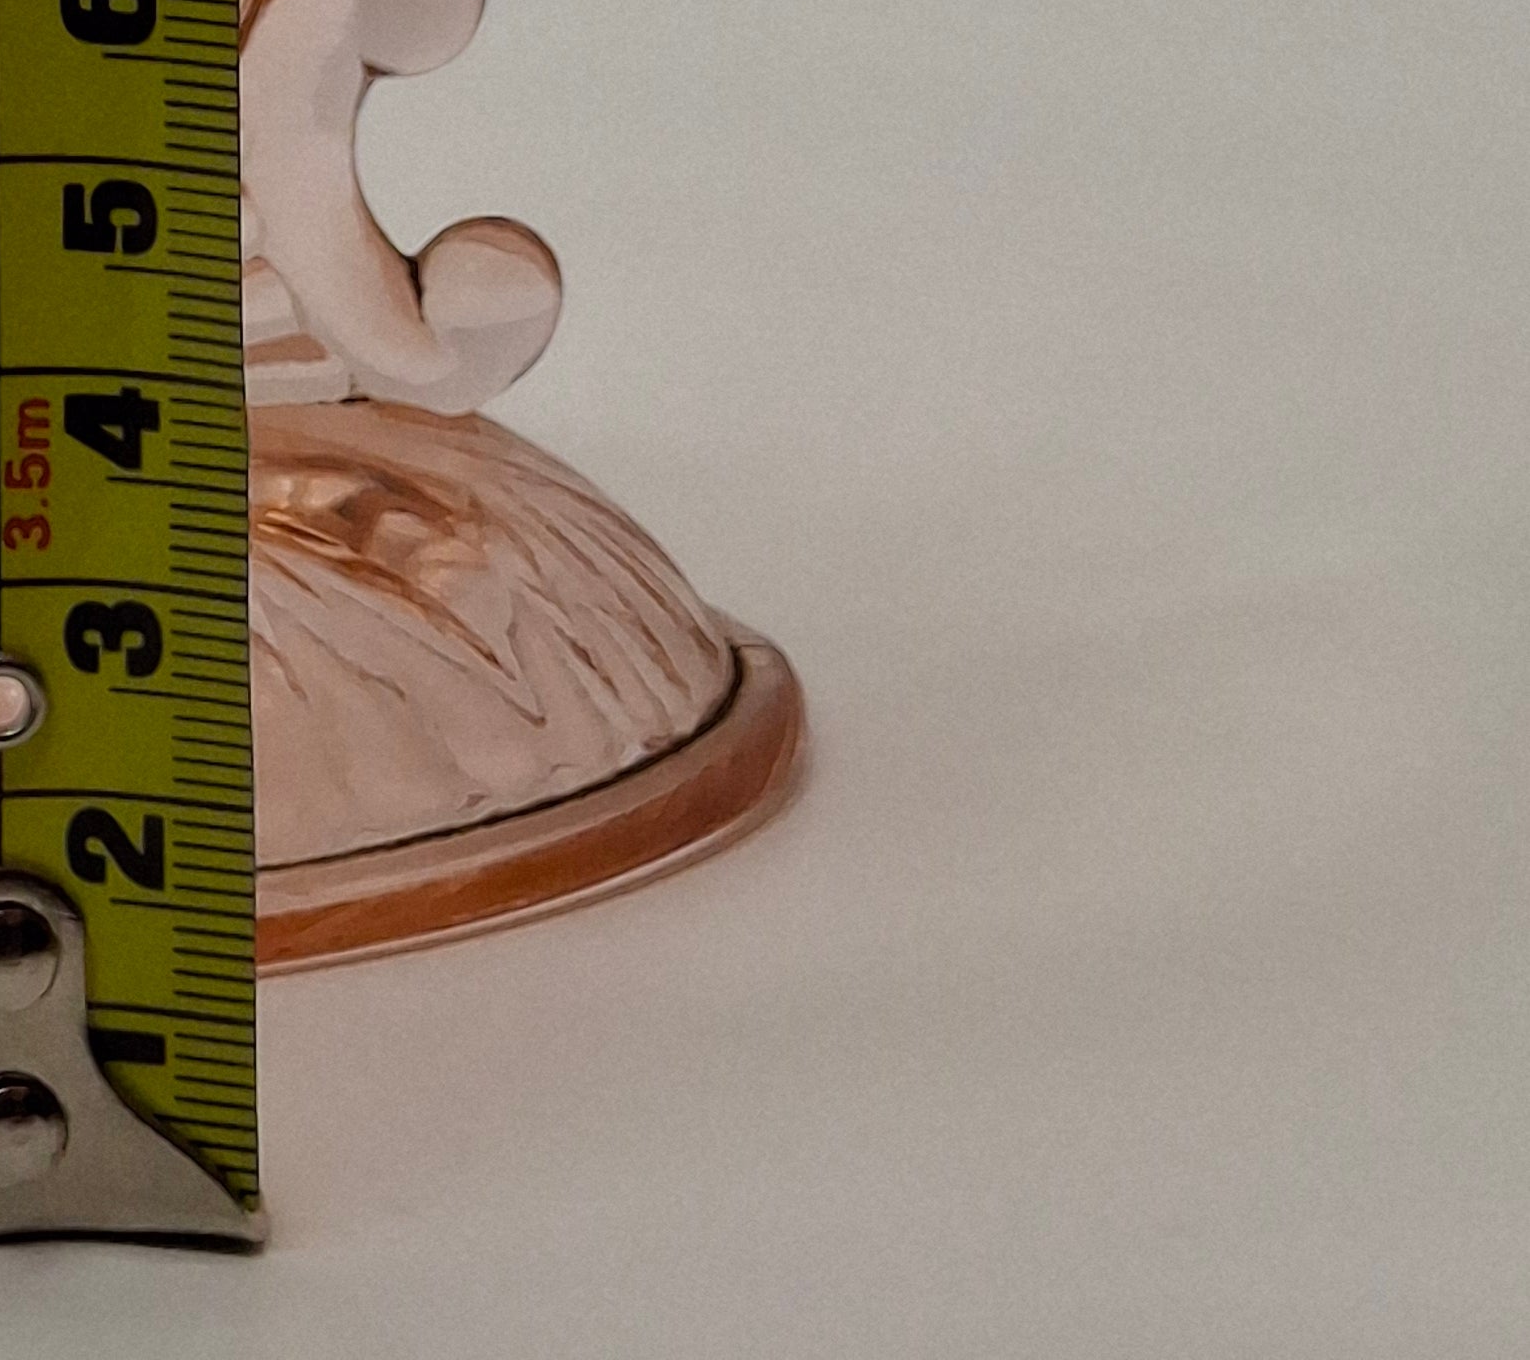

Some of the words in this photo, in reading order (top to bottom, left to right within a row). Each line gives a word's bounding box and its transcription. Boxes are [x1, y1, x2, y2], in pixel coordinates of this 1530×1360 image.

[62, 178, 159, 256] 5
[63, 386, 161, 471] 4
[2, 396, 52, 553] 3.5m
[64, 600, 164, 679] 3
[65, 806, 166, 892] 2
